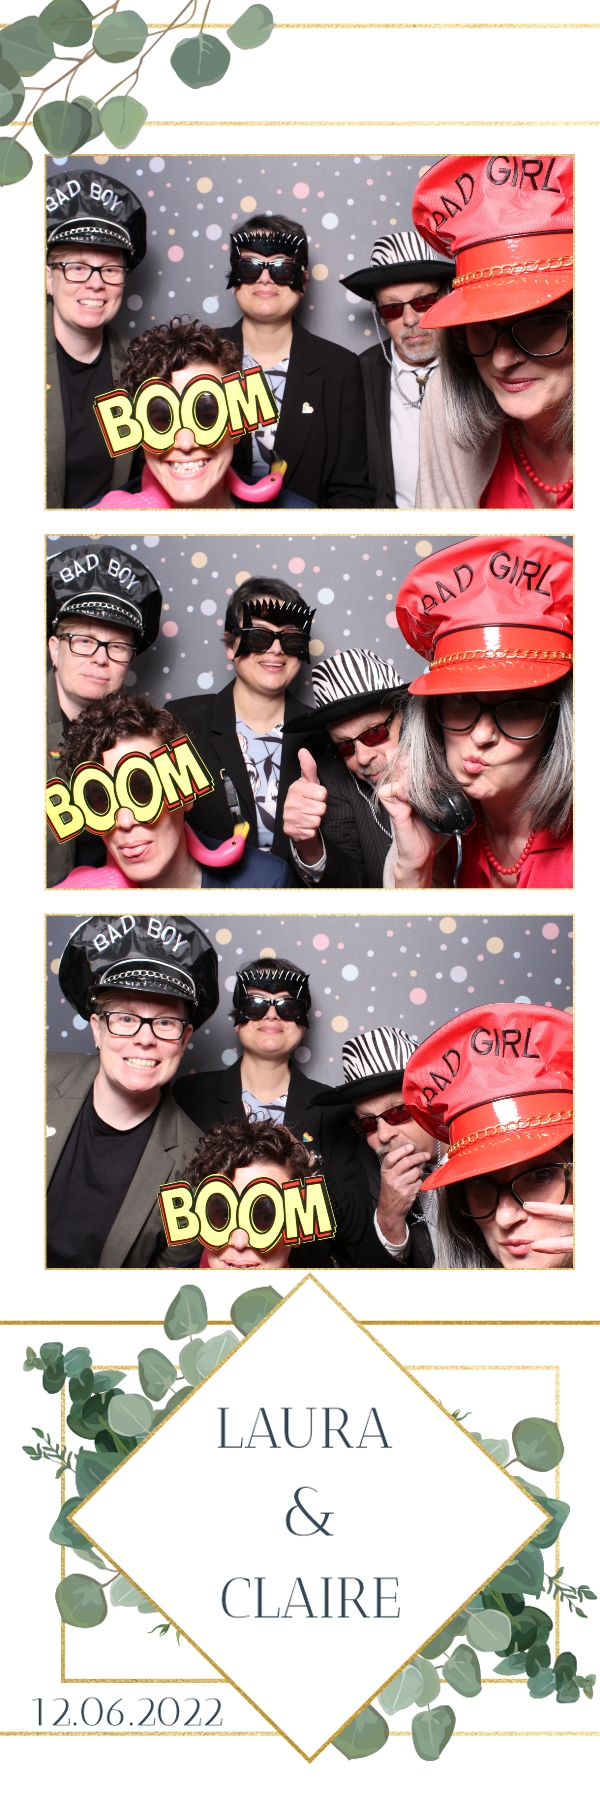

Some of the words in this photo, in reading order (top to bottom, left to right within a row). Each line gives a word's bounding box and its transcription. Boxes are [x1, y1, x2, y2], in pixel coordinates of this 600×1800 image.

[486, 155, 561, 193] GIRL
[46, 180, 81, 212] BAD
[90, 182, 123, 212] BOY
[94, 366, 279, 458] BOOM
[59, 553, 100, 584] BAD
[108, 558, 140, 591] BOY
[489, 551, 552, 597] GIRL
[46, 734, 215, 844] BOOM
[92, 915, 136, 952] BAD
[147, 917, 189, 953] BOY
[470, 1027, 540, 1059] GIRL
[158, 1174, 338, 1253] BOOM
